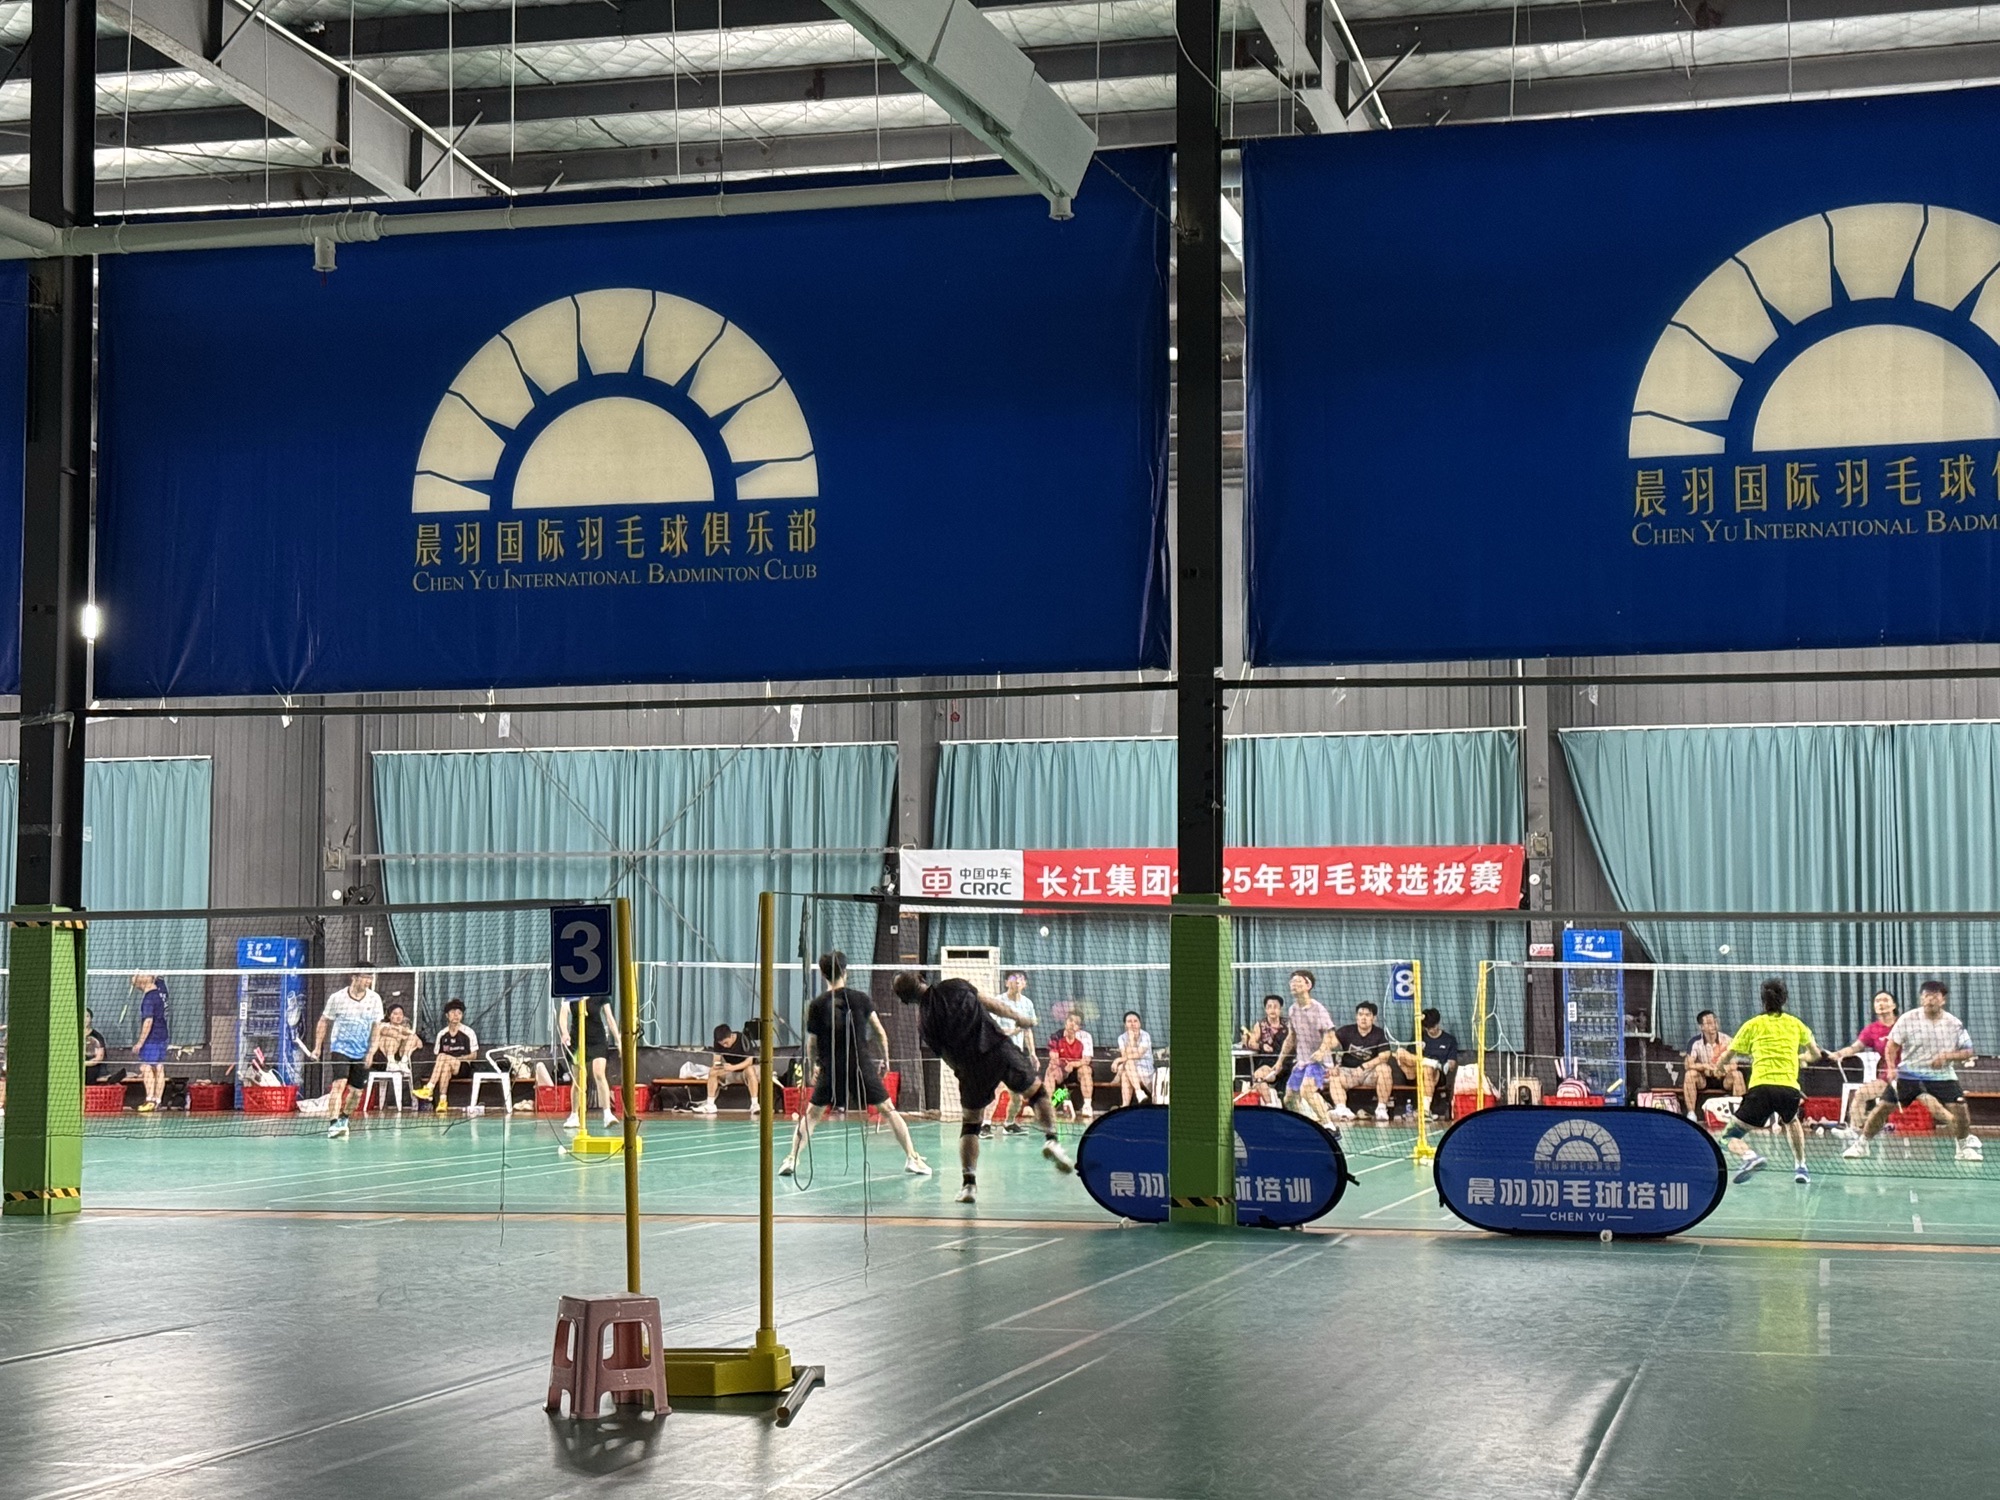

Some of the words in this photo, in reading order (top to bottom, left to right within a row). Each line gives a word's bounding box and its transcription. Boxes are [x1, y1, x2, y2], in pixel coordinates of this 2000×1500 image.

[1633, 451, 2000, 517] 晨羽国际羽毛球
[414, 508, 816, 567] 晨羽国际羽毛球俱乐部
[960, 867, 1012, 880] 中国中车
[960, 882, 1012, 896] CRRC
[560, 921, 602, 984] 3
[1395, 969, 1415, 997] 8
[1467, 1177, 1689, 1211] 晨羽羽毛球培训
[1550, 1211, 1583, 1221] CHEN
[1588, 1212, 1605, 1222] YU
